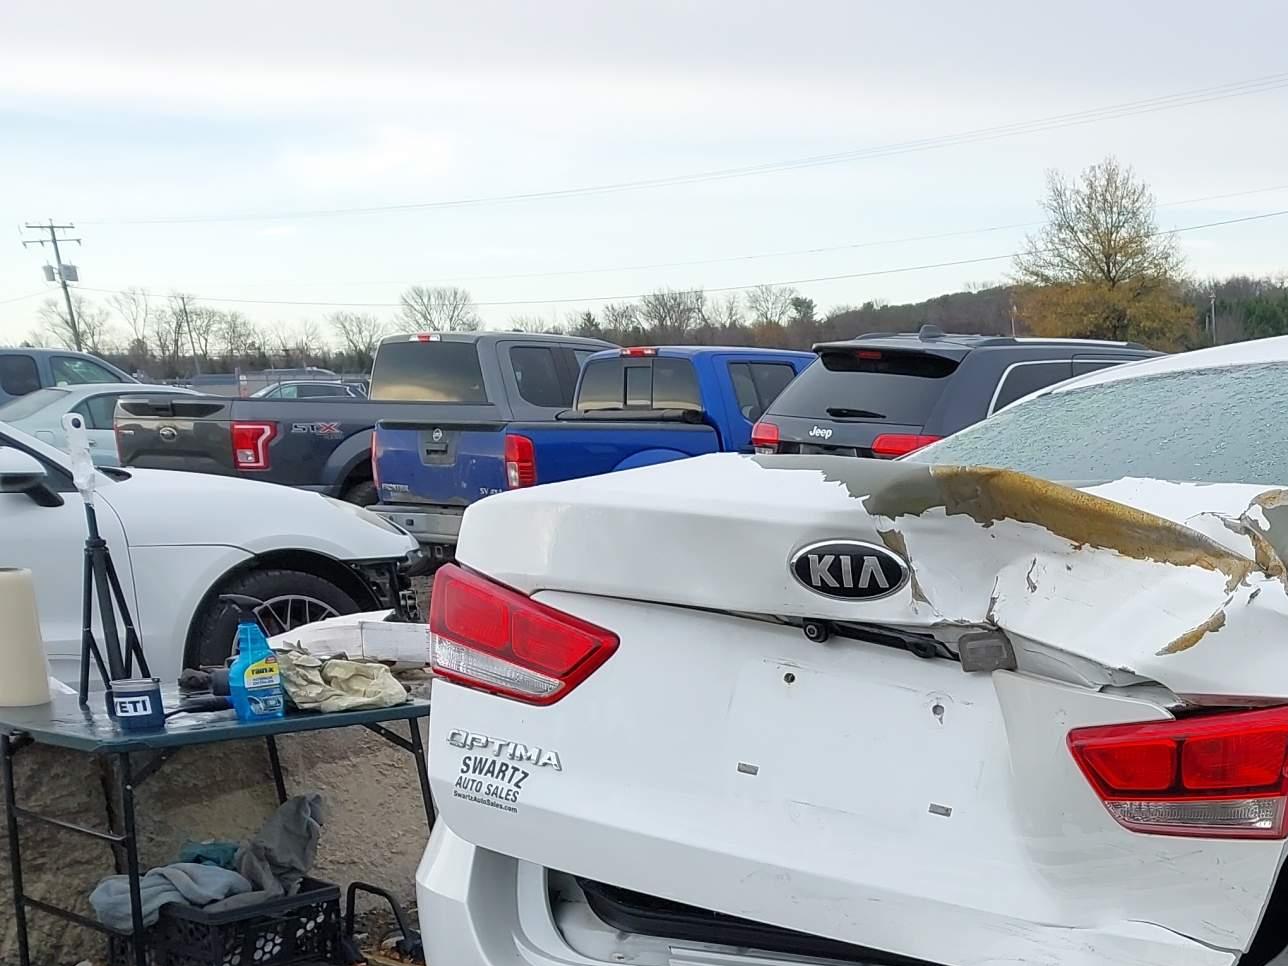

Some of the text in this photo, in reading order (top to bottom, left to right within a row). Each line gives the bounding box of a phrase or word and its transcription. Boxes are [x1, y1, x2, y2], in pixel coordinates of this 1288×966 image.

[291, 422, 339, 433] STX
[809, 425, 833, 440] Jeep
[807, 554, 890, 588] KIA
[115, 700, 148, 713] ETI
[446, 728, 563, 772] OPTIMA
[460, 755, 530, 789] SWARTZ
[453, 789, 518, 814] SwartzAutoSales.com
[455, 775, 520, 803] AUTO SALES
